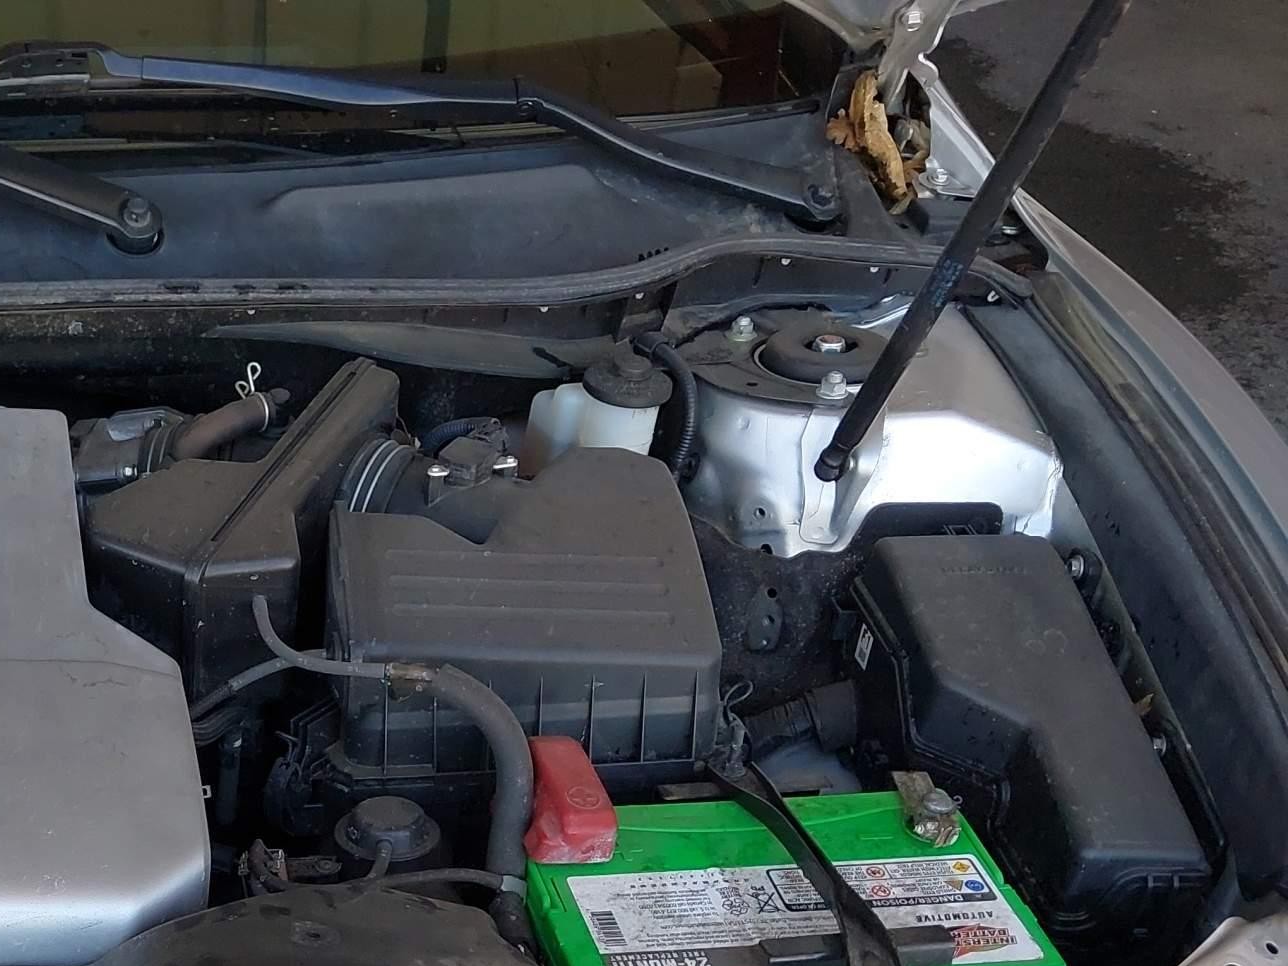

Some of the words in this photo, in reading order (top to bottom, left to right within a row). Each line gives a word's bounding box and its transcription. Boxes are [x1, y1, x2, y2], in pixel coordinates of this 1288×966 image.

[872, 894, 964, 907] DANGER/POISON
[915, 911, 993, 923] AUTOMOTIVE
[950, 928, 1010, 939] BATTER
[953, 935, 1017, 947] INTERST
[610, 952, 679, 961] REPLACEMENT
